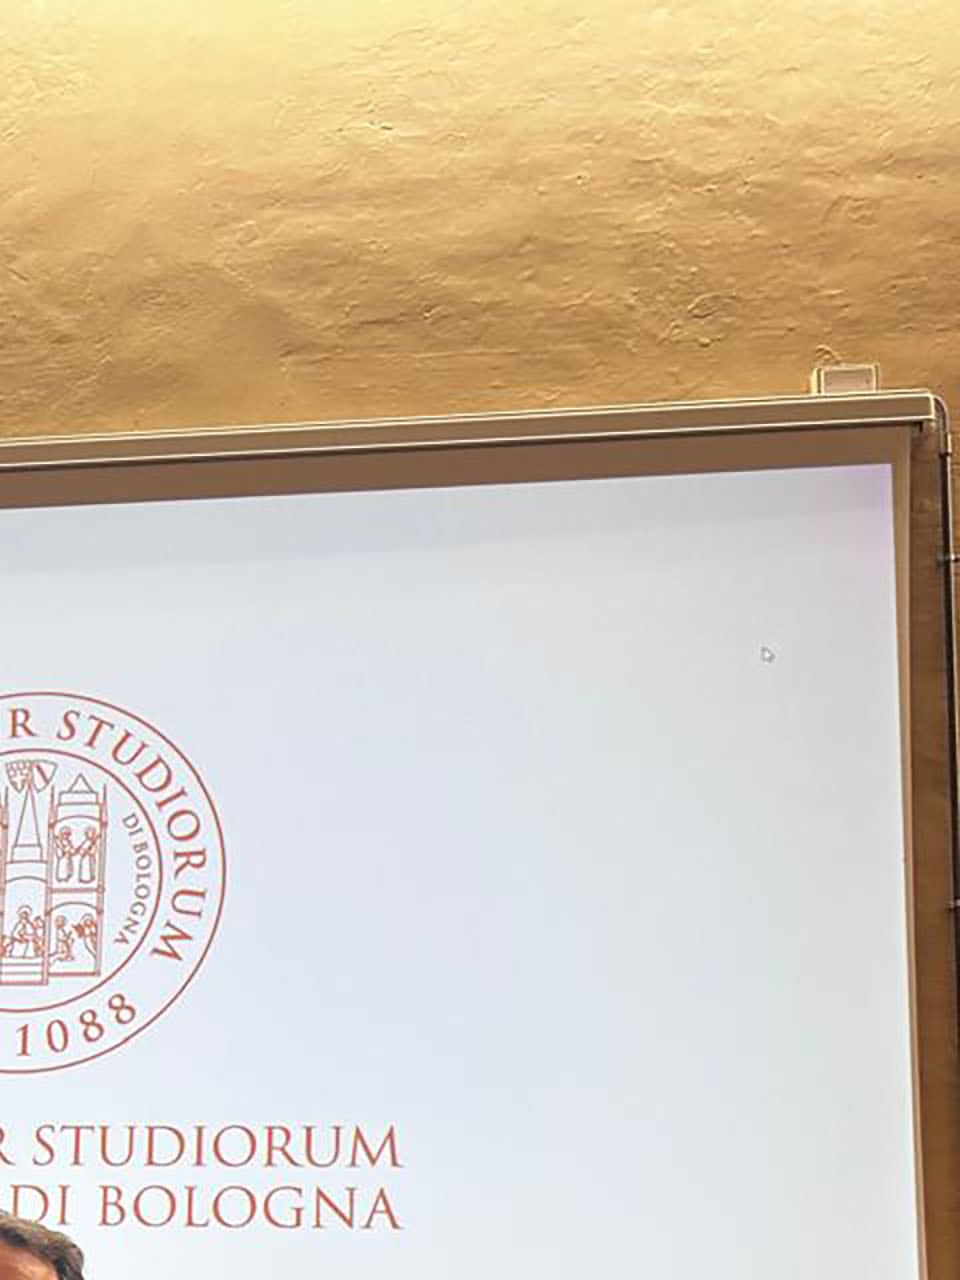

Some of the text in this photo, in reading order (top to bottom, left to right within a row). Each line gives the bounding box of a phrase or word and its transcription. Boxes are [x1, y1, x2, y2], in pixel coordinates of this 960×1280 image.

[55, 708, 208, 964] STUDIORUM
[121, 813, 142, 838] DI
[113, 841, 153, 947] BOLOGNA
[15, 992, 137, 1057] 1088
[31, 1124, 404, 1168] STUDIORUM
[10, 1183, 71, 1226] DI
[97, 1184, 404, 1230] BOLOGNA
